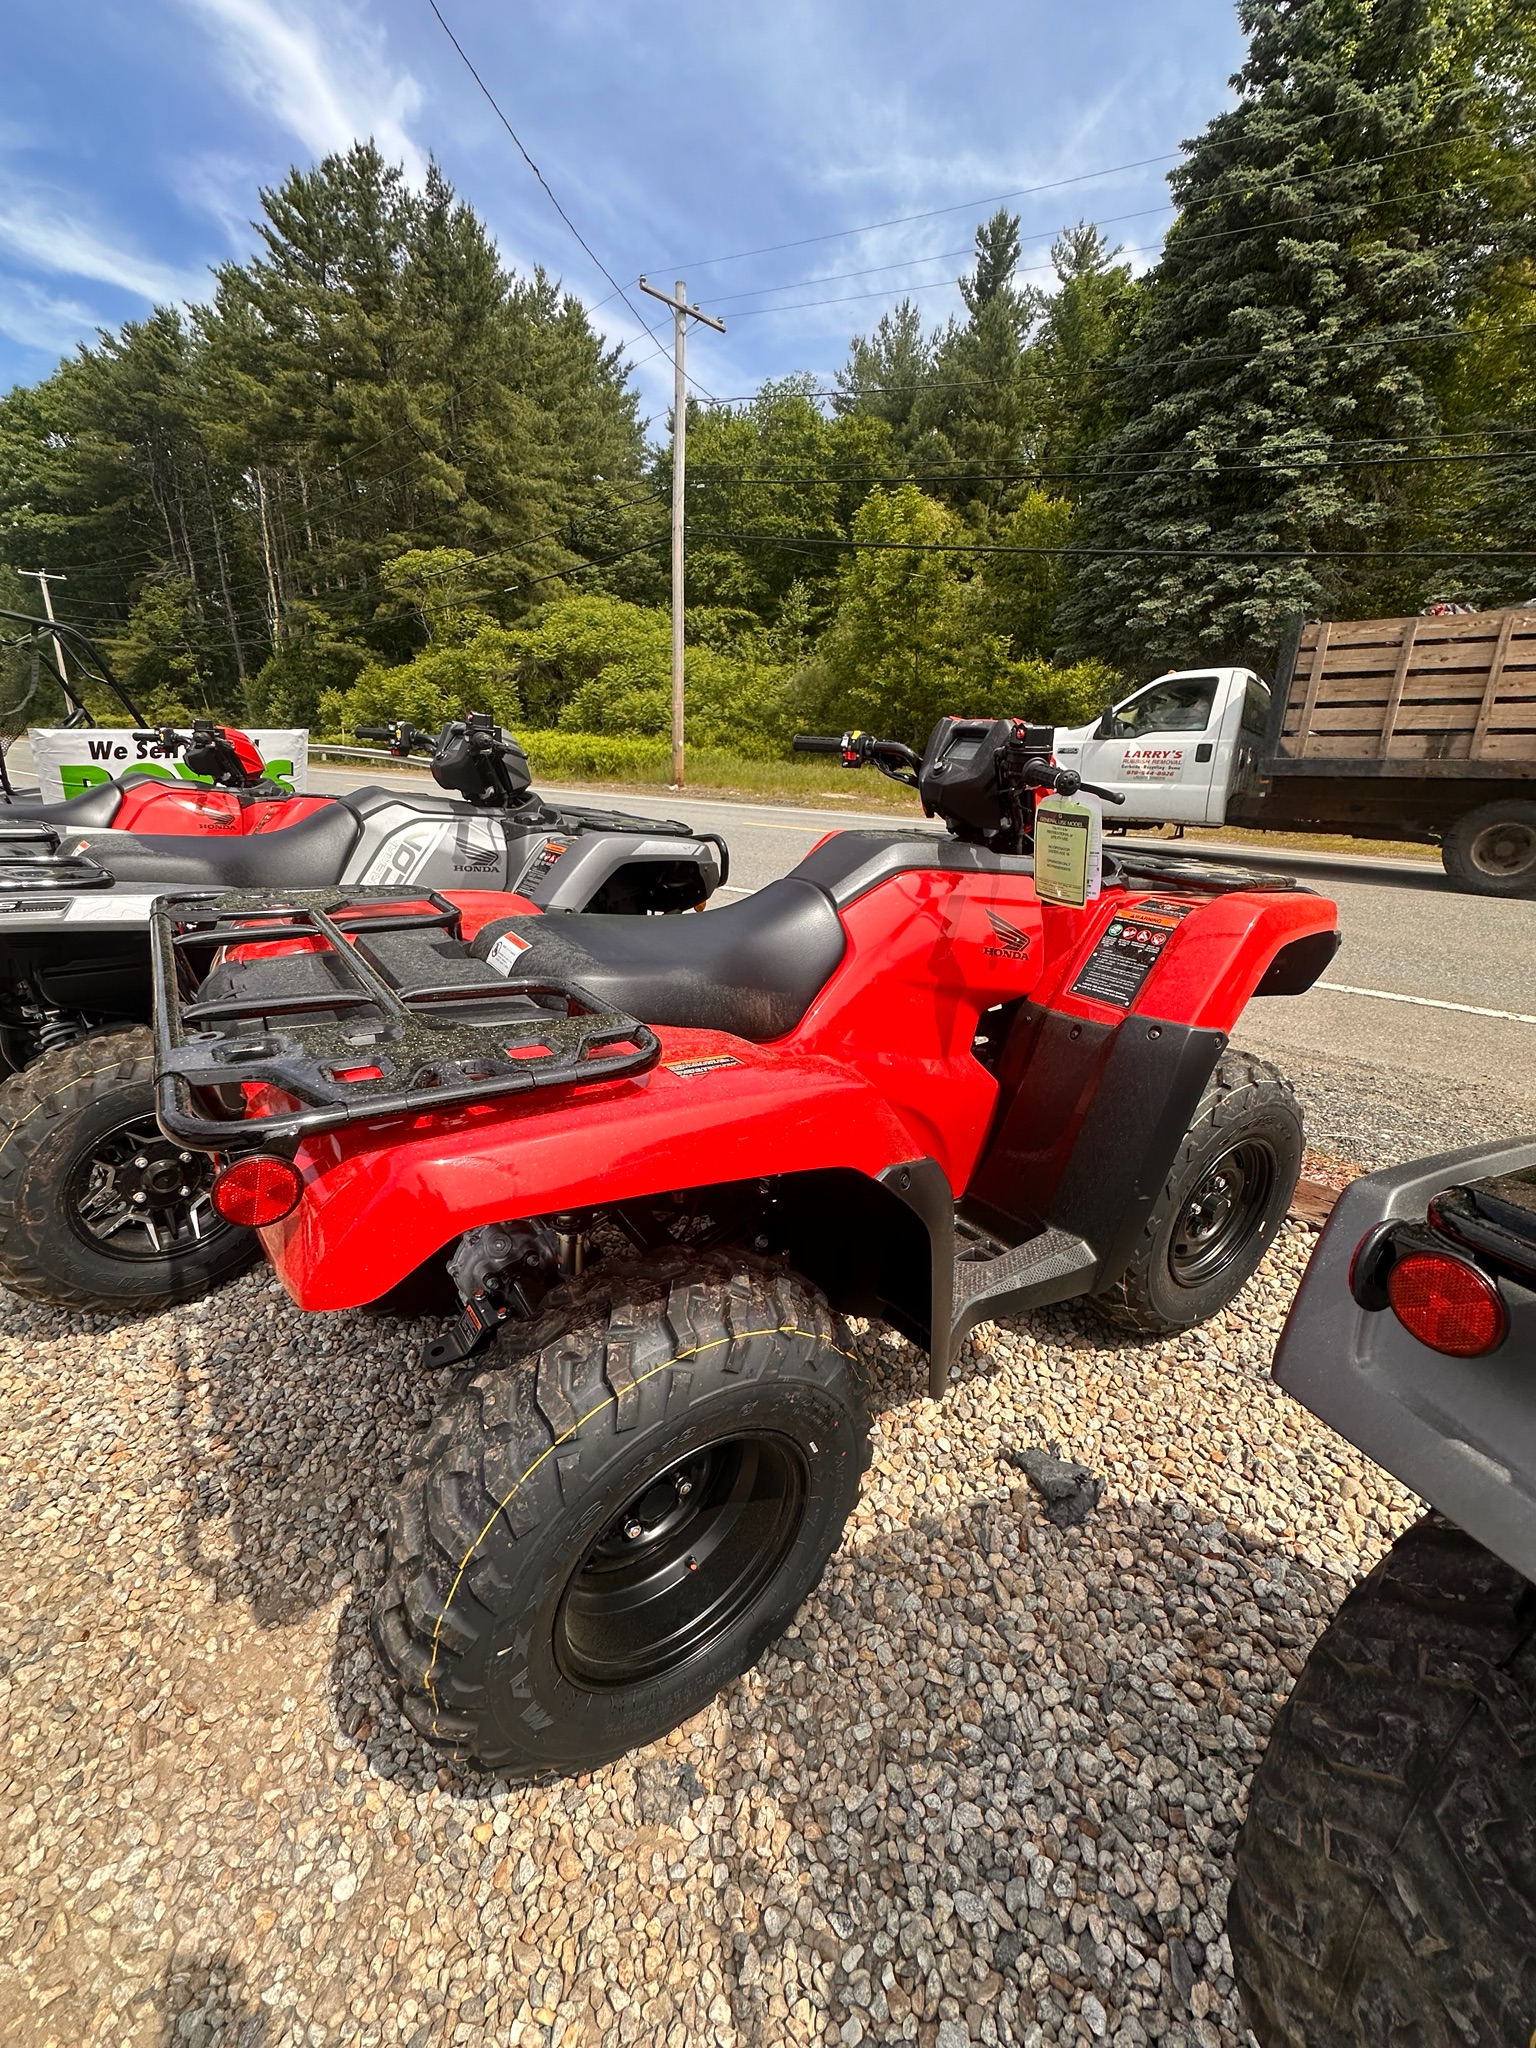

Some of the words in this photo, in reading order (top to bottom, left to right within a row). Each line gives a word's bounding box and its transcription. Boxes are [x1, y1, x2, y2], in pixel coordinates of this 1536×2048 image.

[88, 741, 128, 760] We
[1124, 750, 1183, 759] LARRY'S
[454, 865, 500, 873] HONDA
[1135, 913, 1162, 924] WARNING
[983, 947, 1029, 961] HONDA
